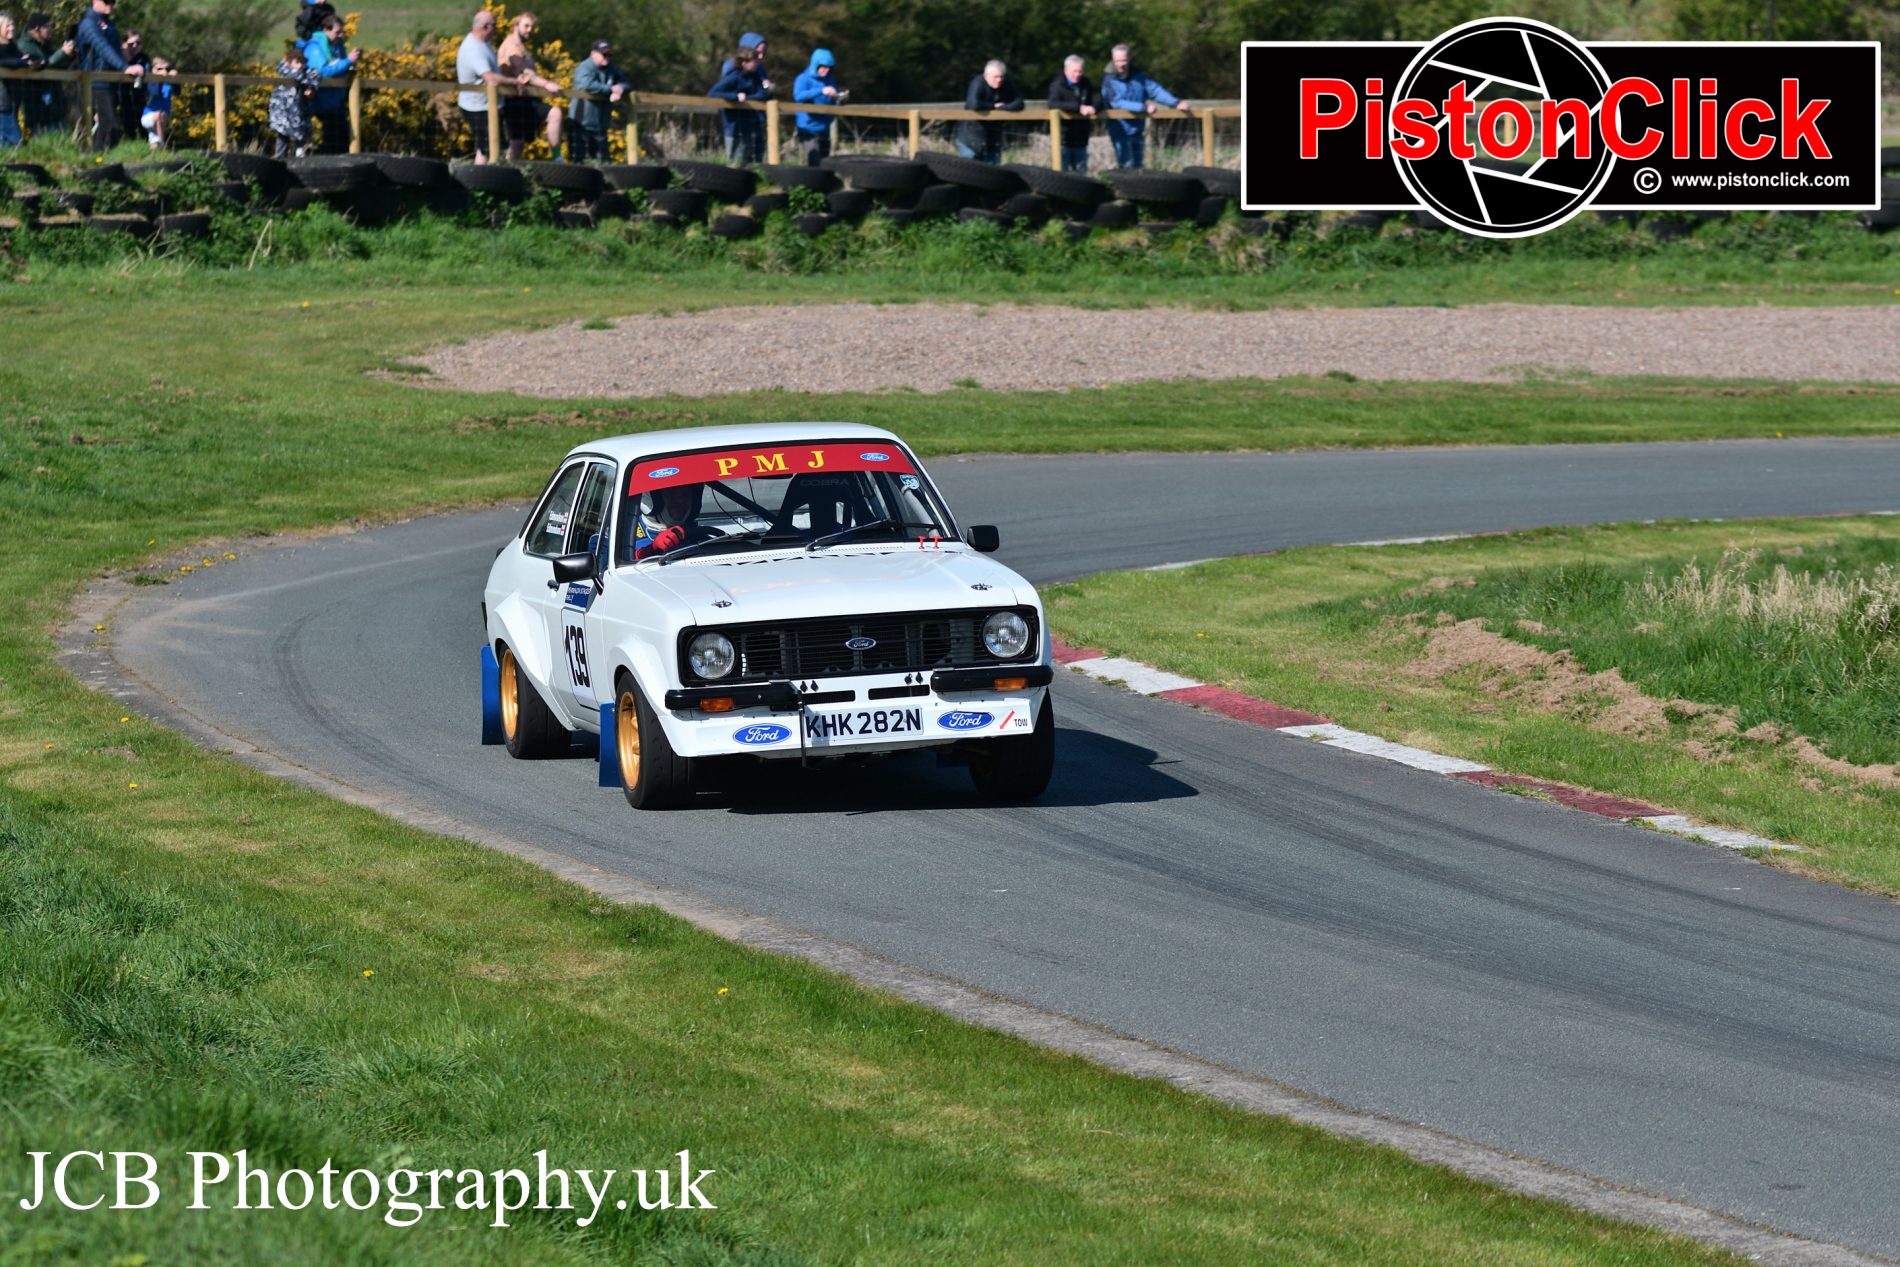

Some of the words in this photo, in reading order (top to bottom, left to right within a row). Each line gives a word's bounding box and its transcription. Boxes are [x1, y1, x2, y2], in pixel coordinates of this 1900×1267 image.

[565, 624, 591, 688] 139
[805, 713, 854, 738] KHK
[857, 708, 922, 734] 282N
[948, 711, 982, 727] Ford
[1013, 718, 1028, 727] TOW
[745, 726, 780, 742] Ford
